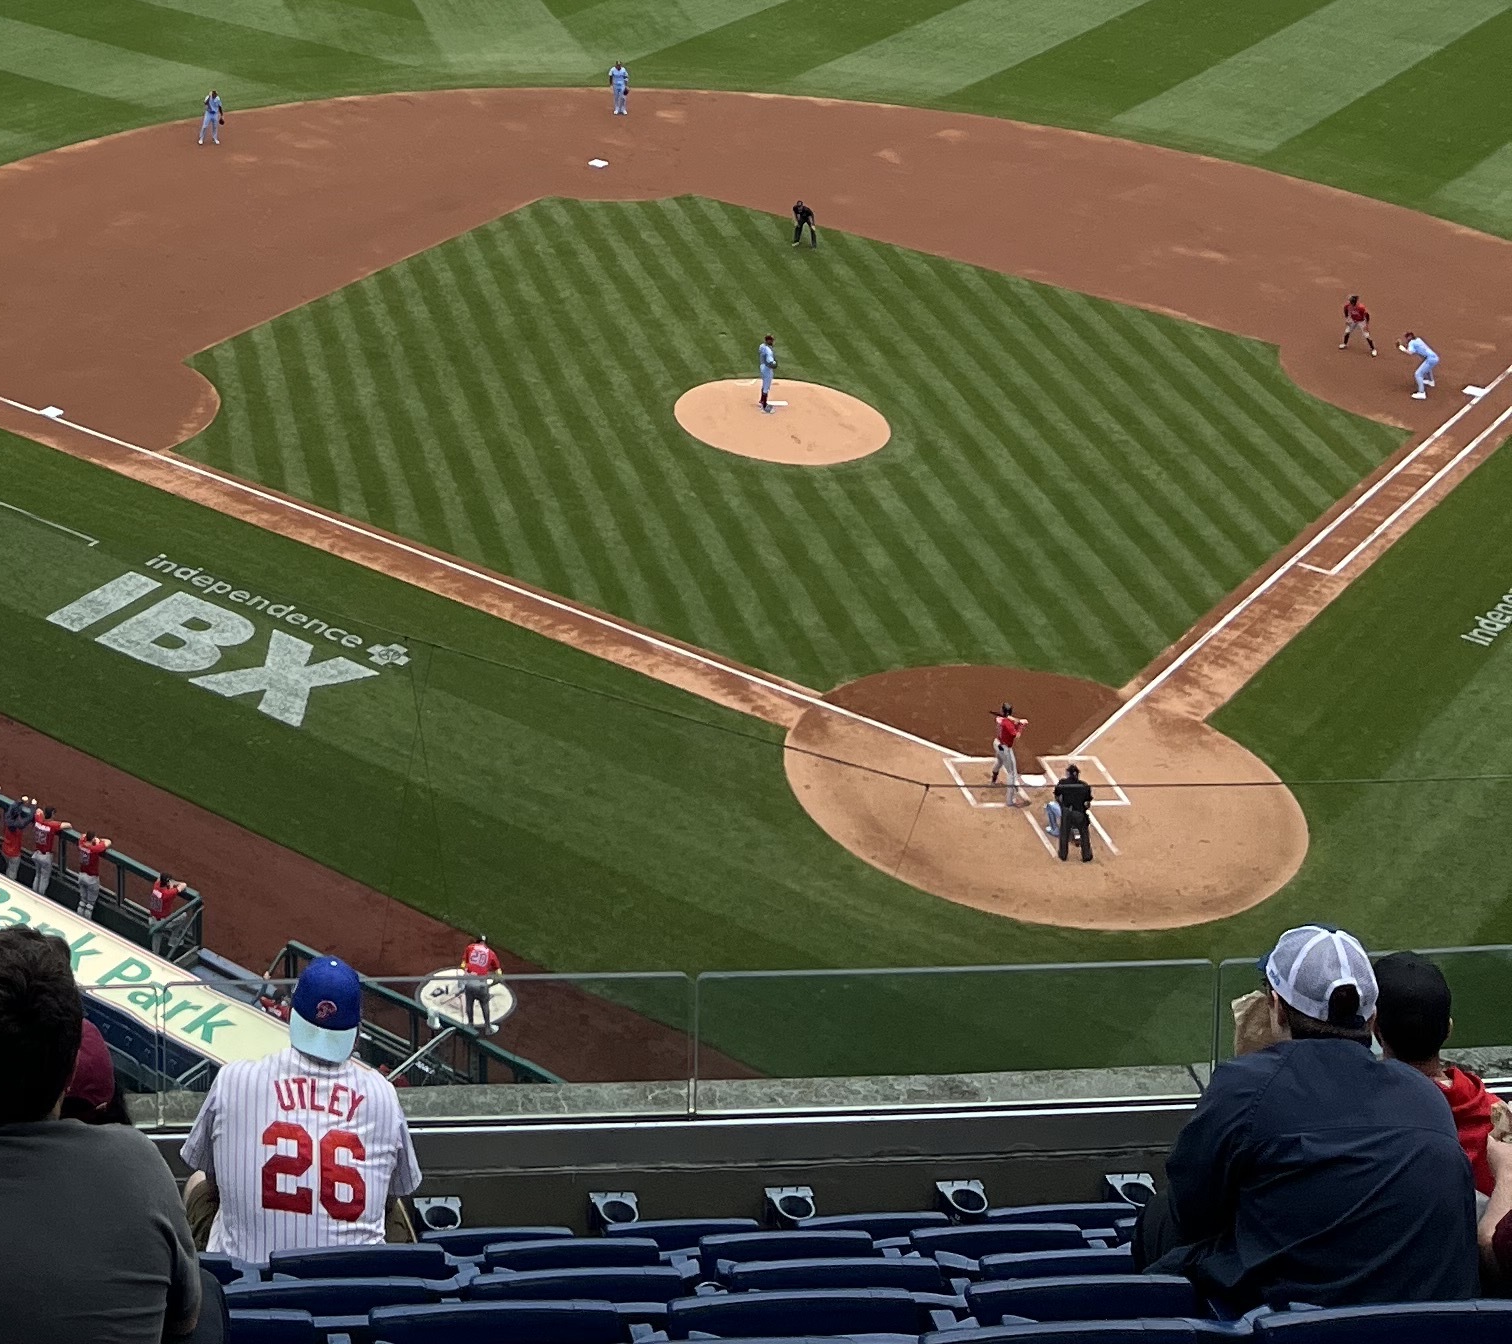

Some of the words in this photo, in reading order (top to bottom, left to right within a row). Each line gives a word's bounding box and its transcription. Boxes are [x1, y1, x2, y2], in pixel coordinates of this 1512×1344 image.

[46, 571, 380, 727] IBX
[144, 553, 364, 649] independence
[98, 955, 237, 1044] Park
[274, 1077, 365, 1123] UTLEY
[262, 1120, 366, 1223] 26
